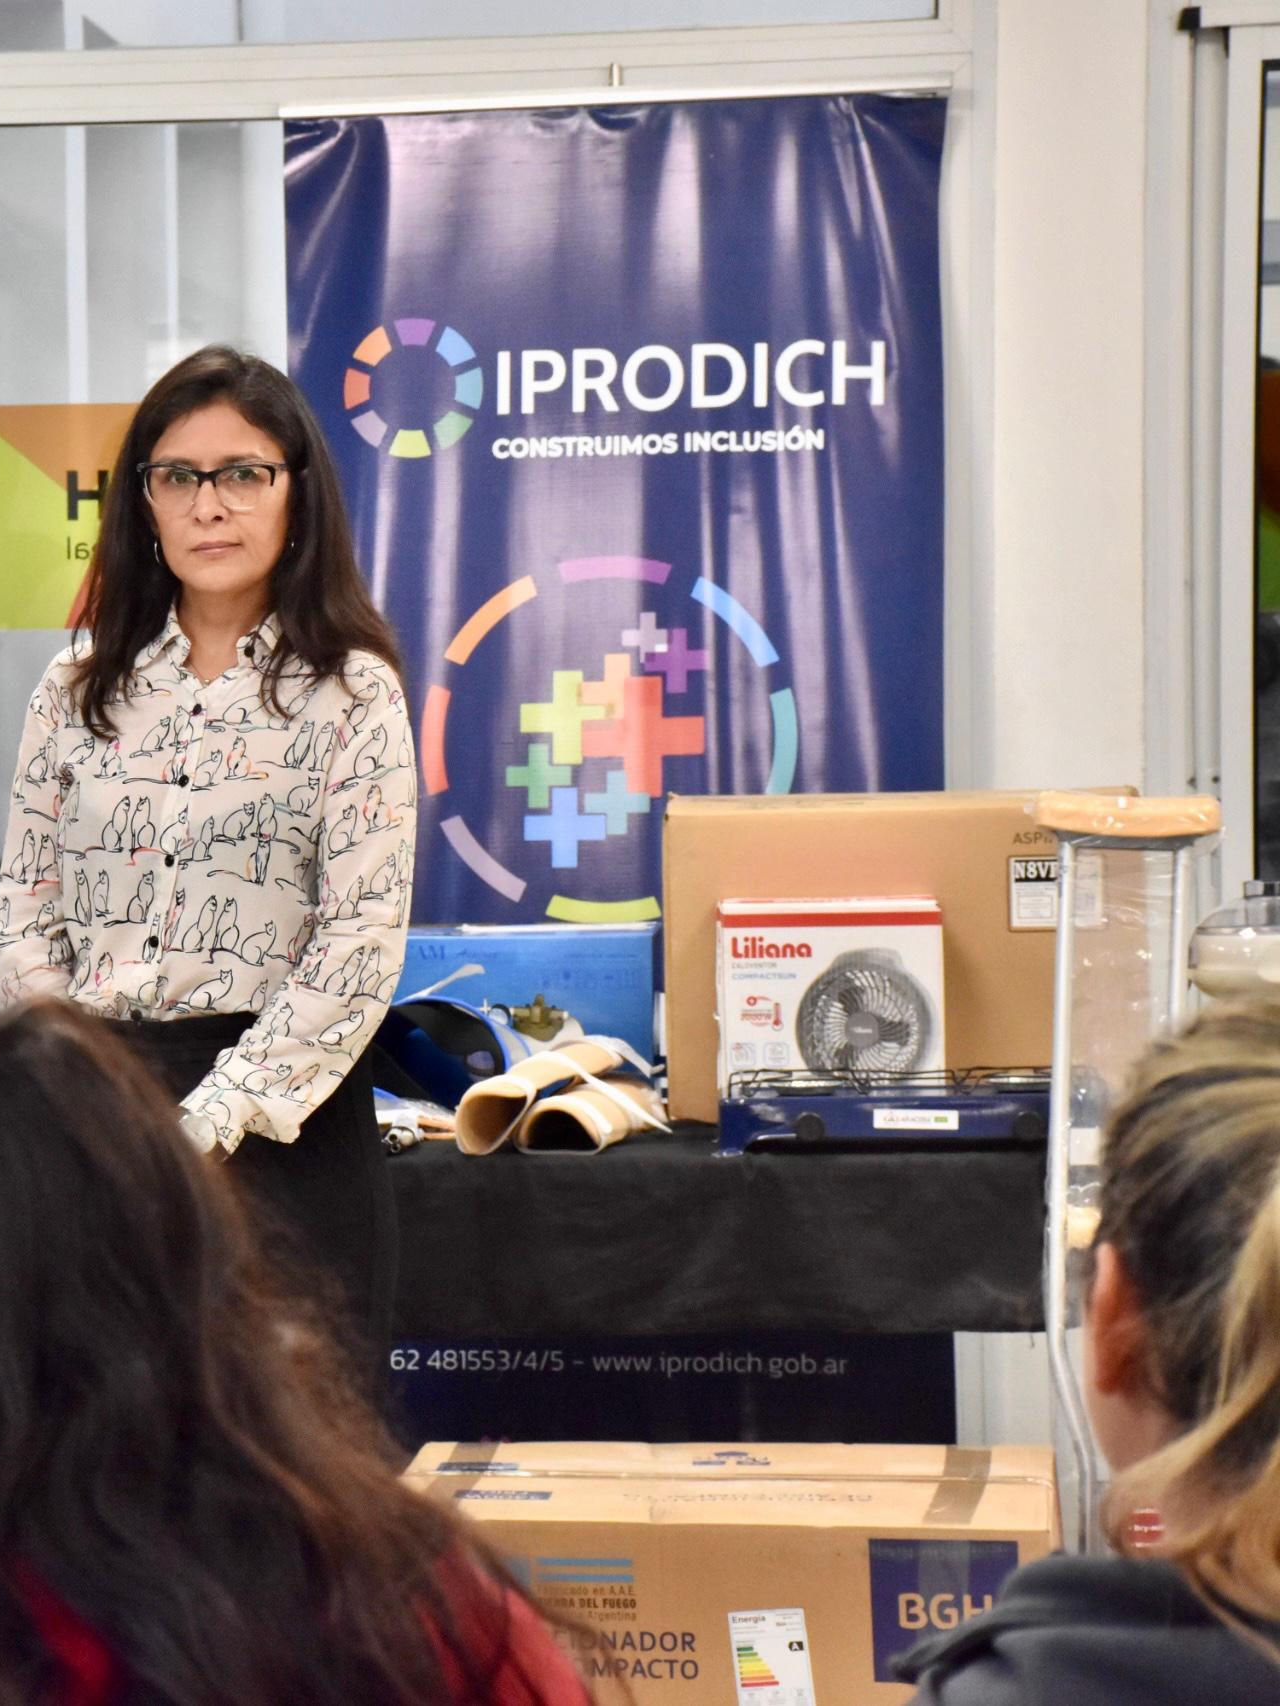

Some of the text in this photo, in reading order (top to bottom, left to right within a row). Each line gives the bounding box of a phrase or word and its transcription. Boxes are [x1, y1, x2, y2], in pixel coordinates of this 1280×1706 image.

[496, 340, 887, 415] IPRODICH
[492, 426, 825, 459] CONSTRUIMOS INCLUSIÓN
[731, 936, 813, 959] Liliana
[426, 1348, 564, 1372] 481553/4/5
[593, 1350, 848, 1379] www.iprodich.gob.ar
[579, 1598, 599, 1609] DEL
[602, 1598, 638, 1610] FUEGO
[588, 1610, 638, 1622] Argentina
[897, 1592, 993, 1631] BGH
